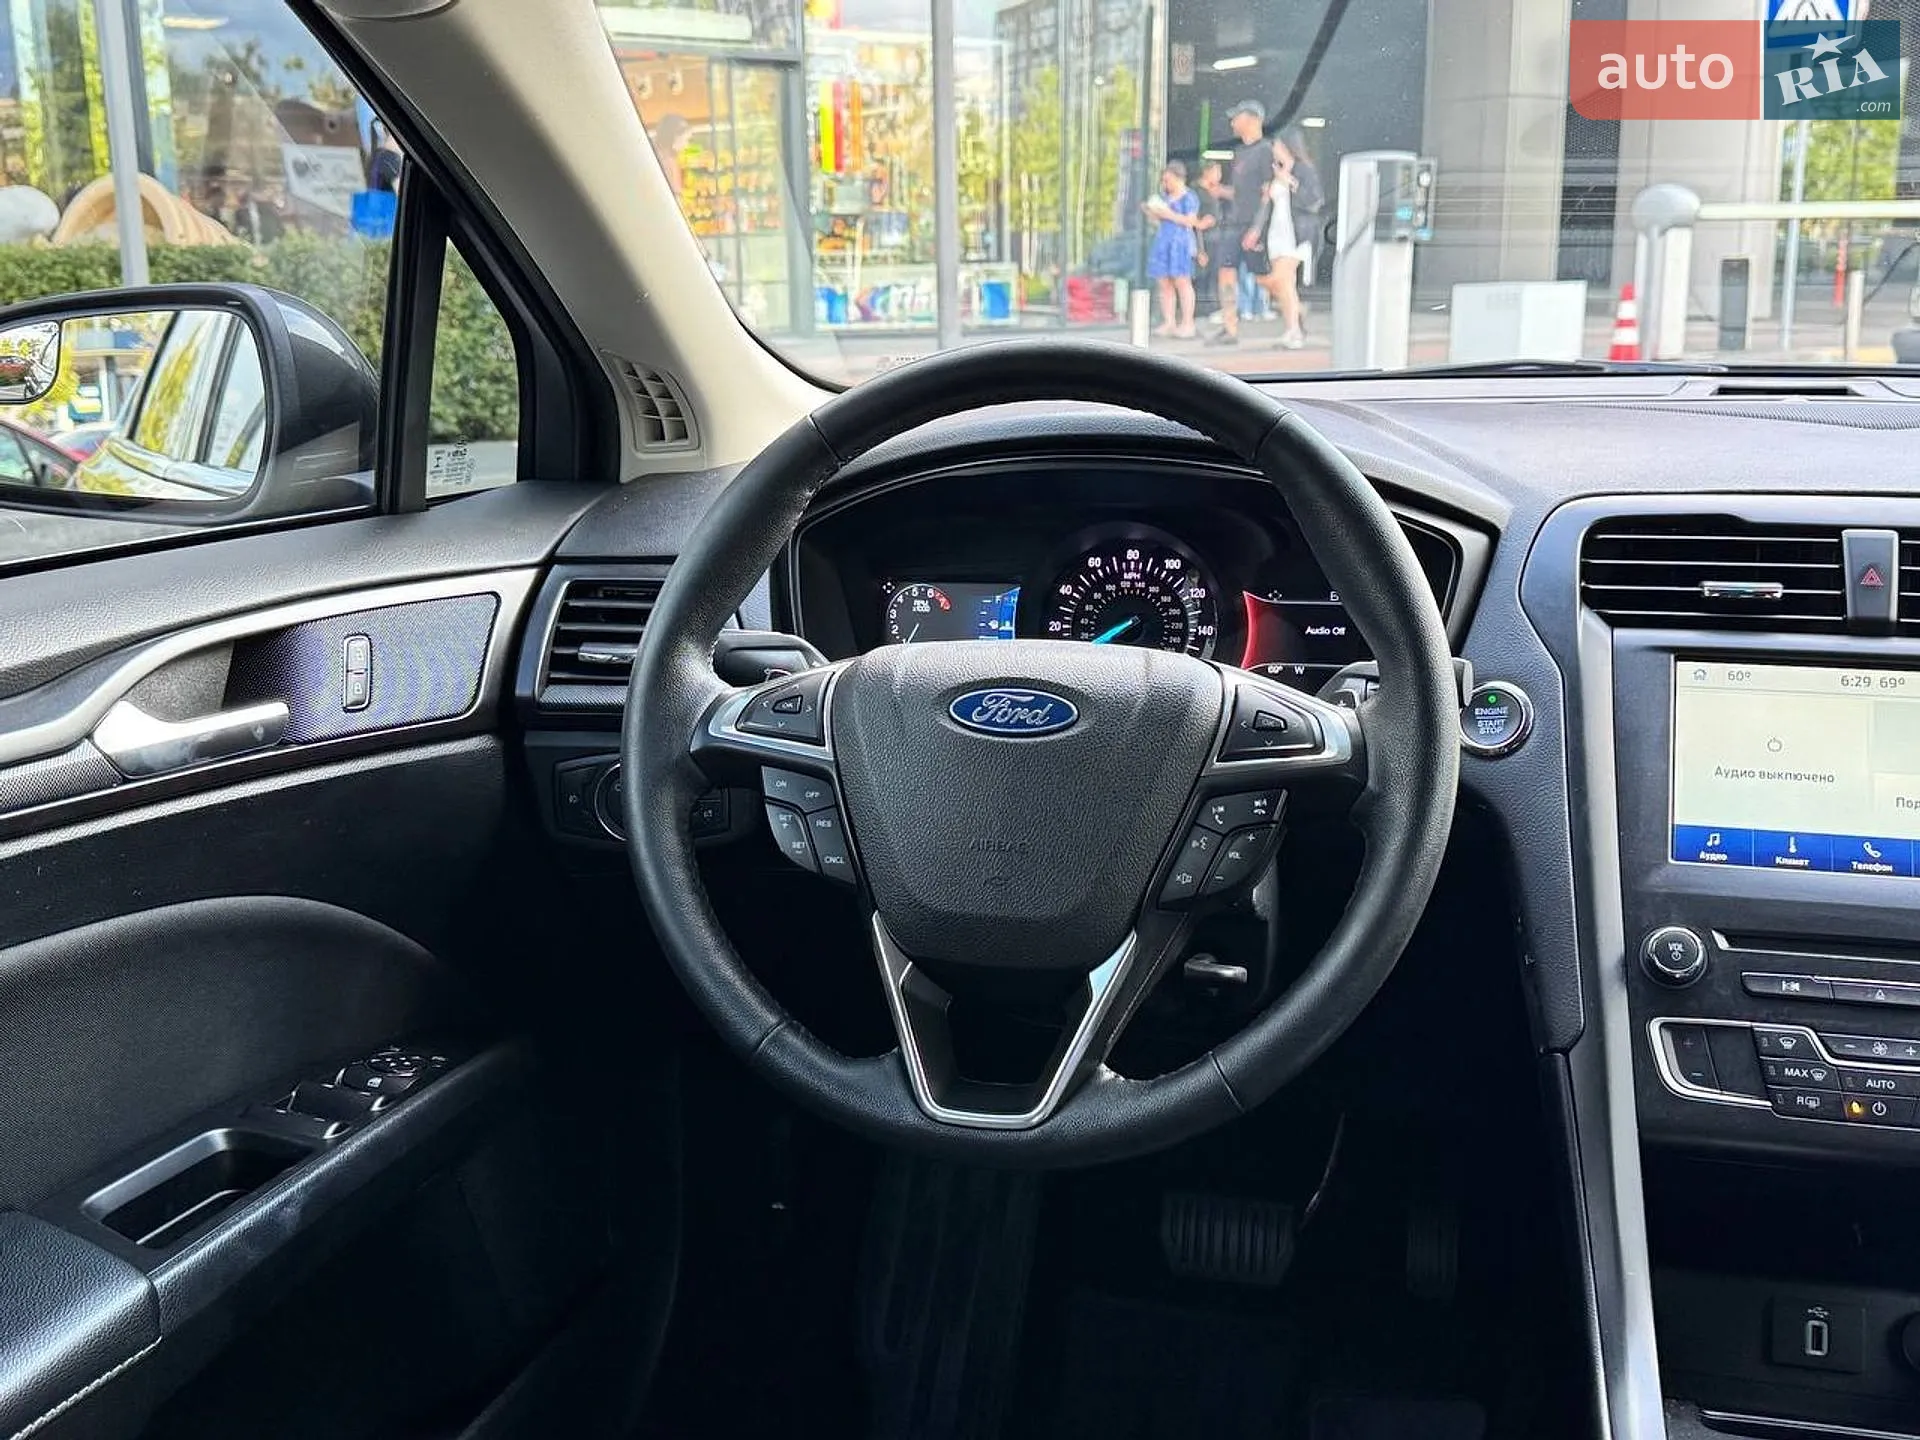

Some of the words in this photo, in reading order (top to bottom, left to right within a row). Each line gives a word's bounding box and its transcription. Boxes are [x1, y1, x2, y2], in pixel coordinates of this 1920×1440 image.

[1126, 549, 1140, 560] 80
[1087, 557, 1101, 568] 60
[1164, 559, 1181, 570] 100
[1059, 584, 1072, 595] 40
[1189, 588, 1206, 598] 120
[890, 609, 897, 619] 3
[891, 625, 899, 635] 2
[1049, 621, 1062, 632] 20
[1197, 625, 1213, 636] 140
[1305, 626, 1331, 635] Audio
[1332, 626, 1346, 636] Off
[1294, 665, 1305, 675] W
[1840, 674, 1872, 688] 6:29
[1879, 676, 1906, 689] 69°
[972, 693, 1054, 725] Ford
[1474, 706, 1509, 716] ENGINE
[1477, 719, 1505, 728] START
[1479, 727, 1503, 735] STOP
[1714, 765, 1756, 780] Аудио
[1758, 768, 1835, 784] выключено
[779, 814, 793, 822] SET
[815, 819, 832, 828] RES
[824, 856, 845, 865] CNCL
[1699, 850, 1728, 863] Аудио
[1775, 855, 1810, 867] Климат
[1851, 860, 1893, 873] Телефон
[1668, 942, 1684, 952] VOL
[1784, 1067, 1808, 1078] MAX
[1865, 1079, 1896, 1090] AUTO
